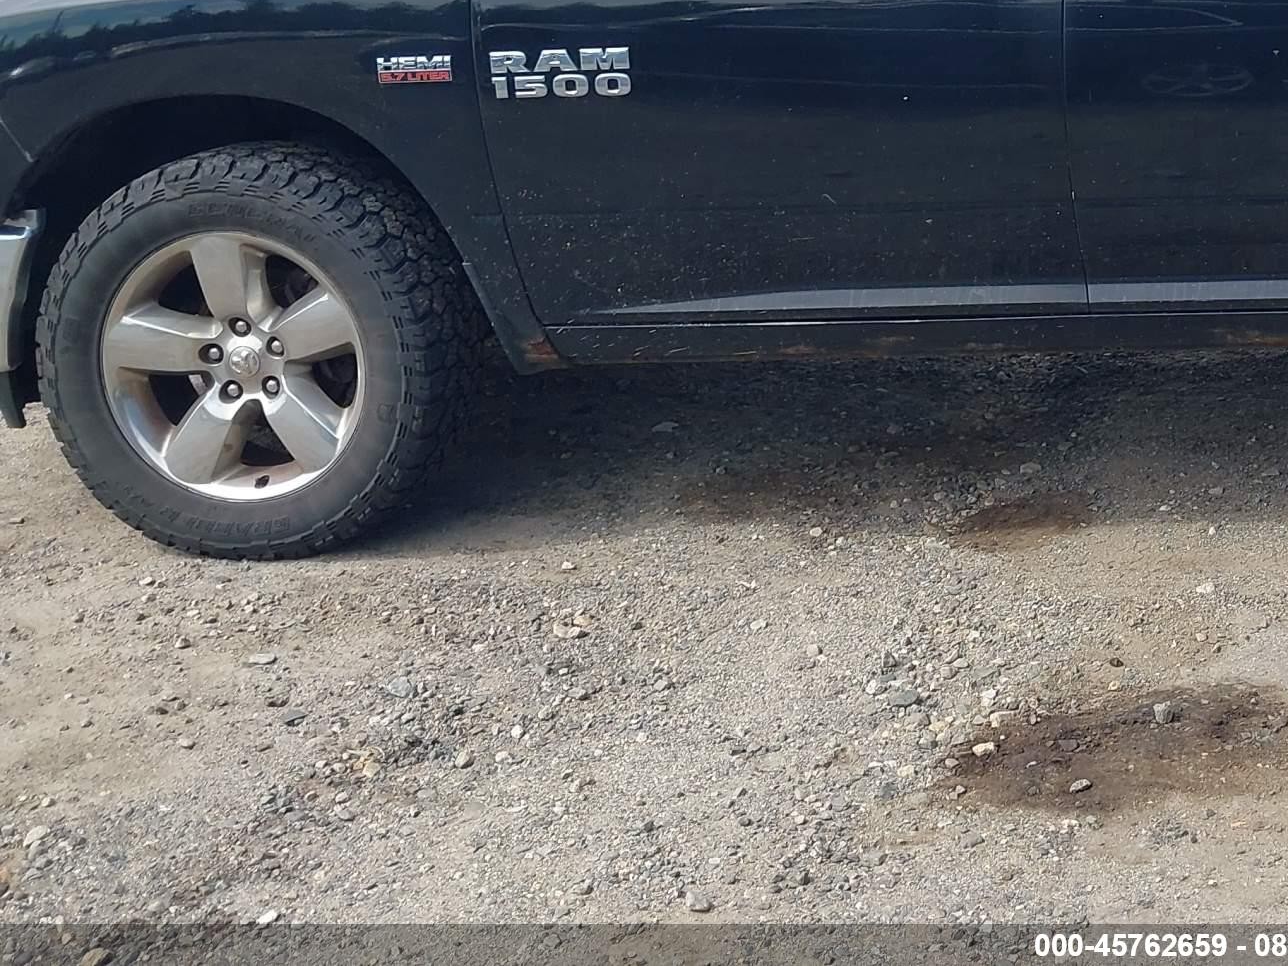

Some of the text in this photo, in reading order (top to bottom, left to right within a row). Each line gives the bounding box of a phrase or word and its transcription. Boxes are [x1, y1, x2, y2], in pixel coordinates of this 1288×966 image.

[376, 55, 451, 71] HEMI
[489, 46, 630, 73] RAM
[381, 71, 450, 82] 5.7 LITER
[491, 72, 632, 99] 1500
